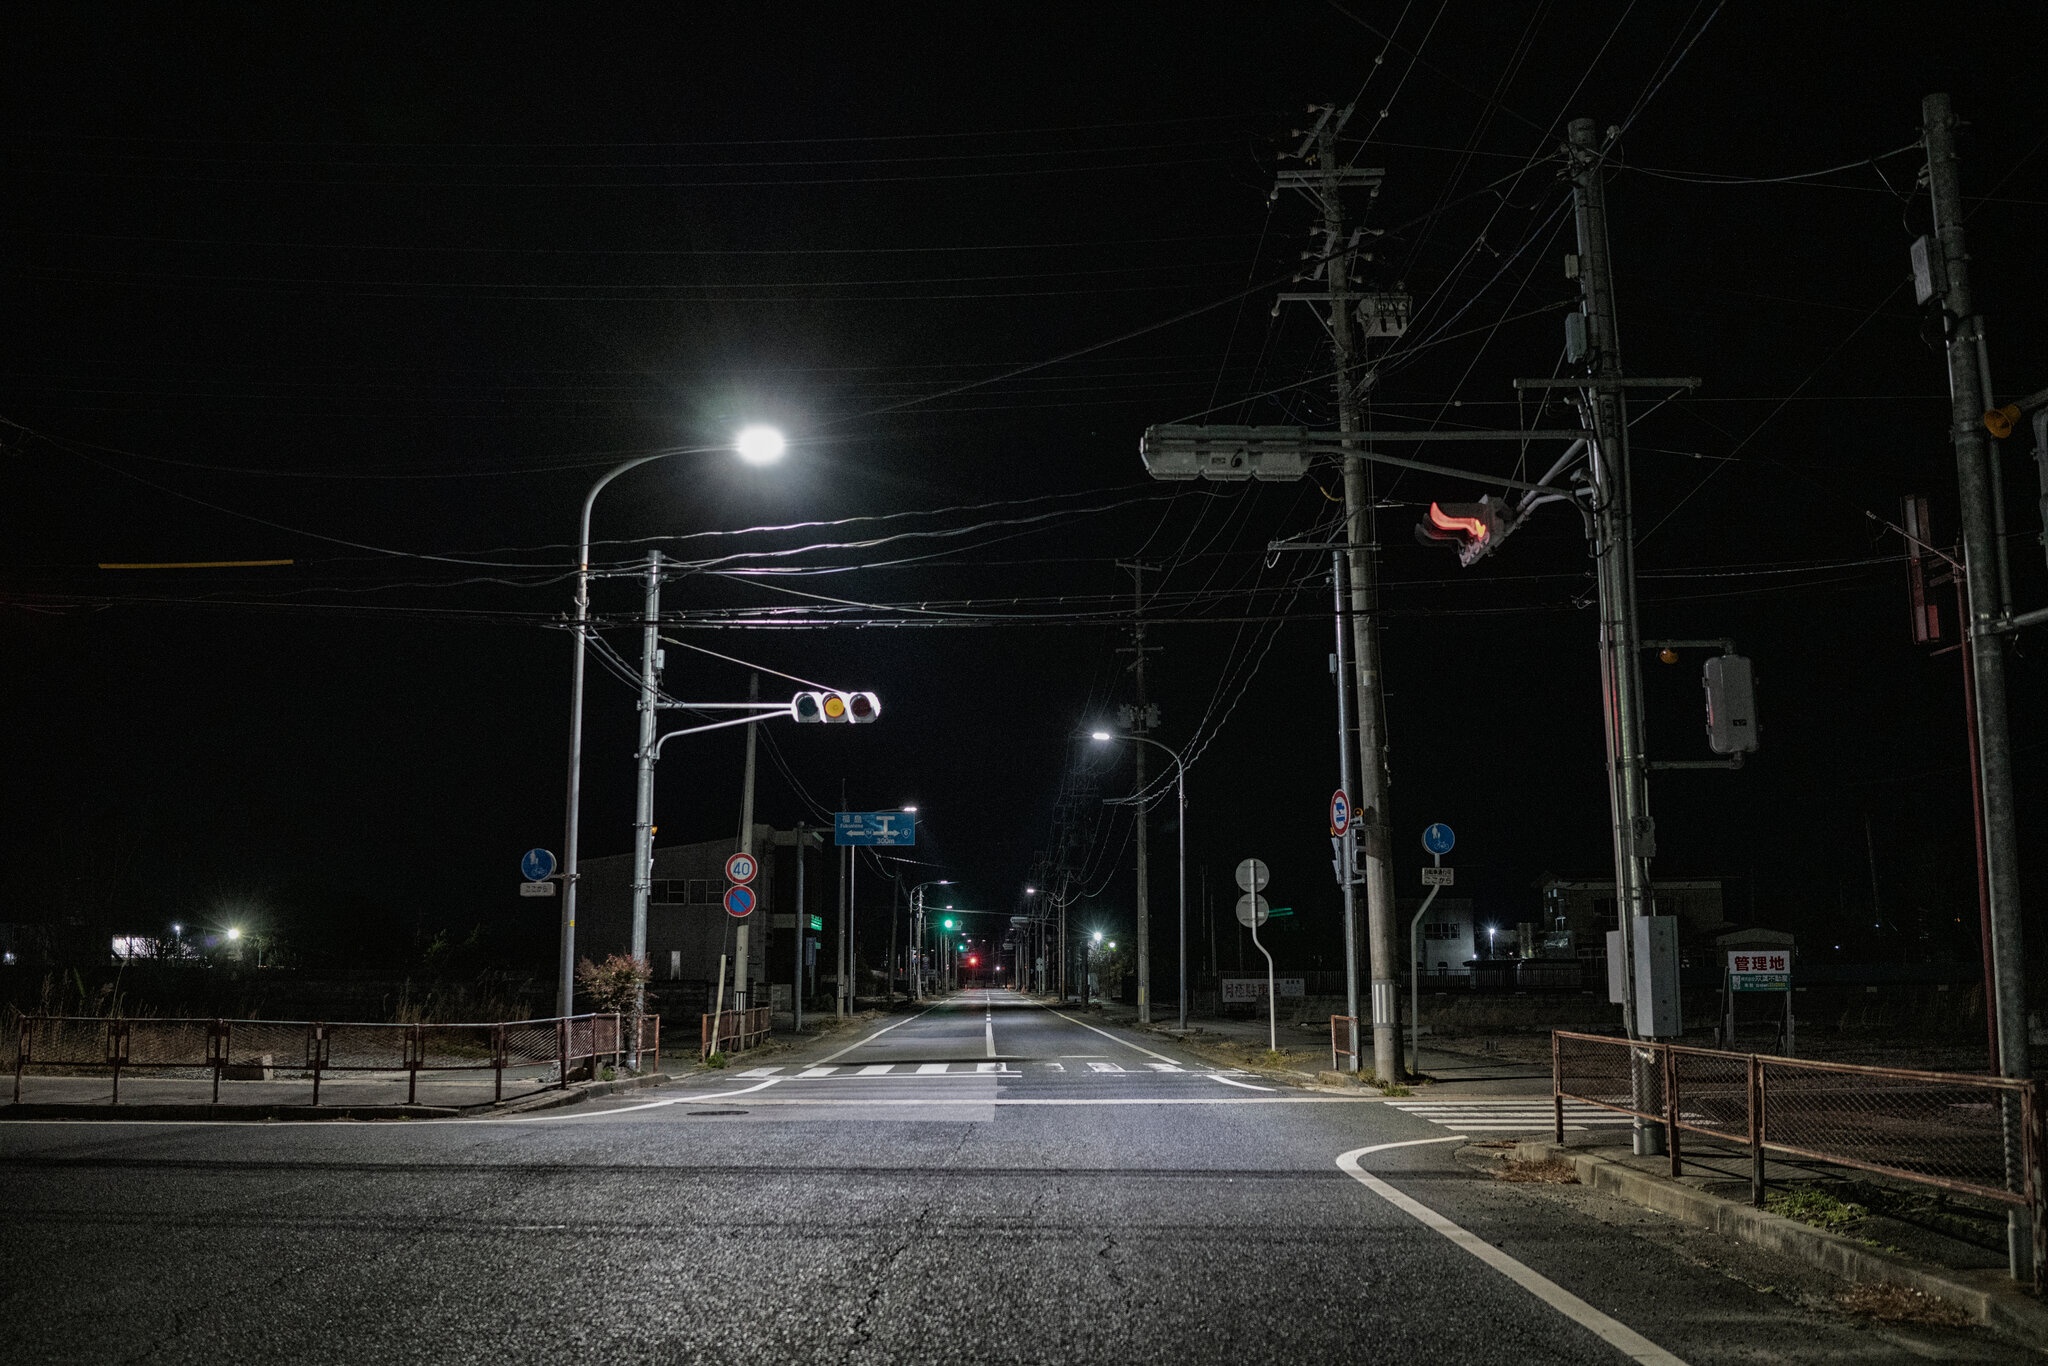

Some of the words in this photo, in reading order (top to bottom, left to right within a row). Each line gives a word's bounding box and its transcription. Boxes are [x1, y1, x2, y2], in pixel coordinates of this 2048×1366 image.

[733, 862, 750, 875] 40
[1734, 955, 1785, 971] 管理地
